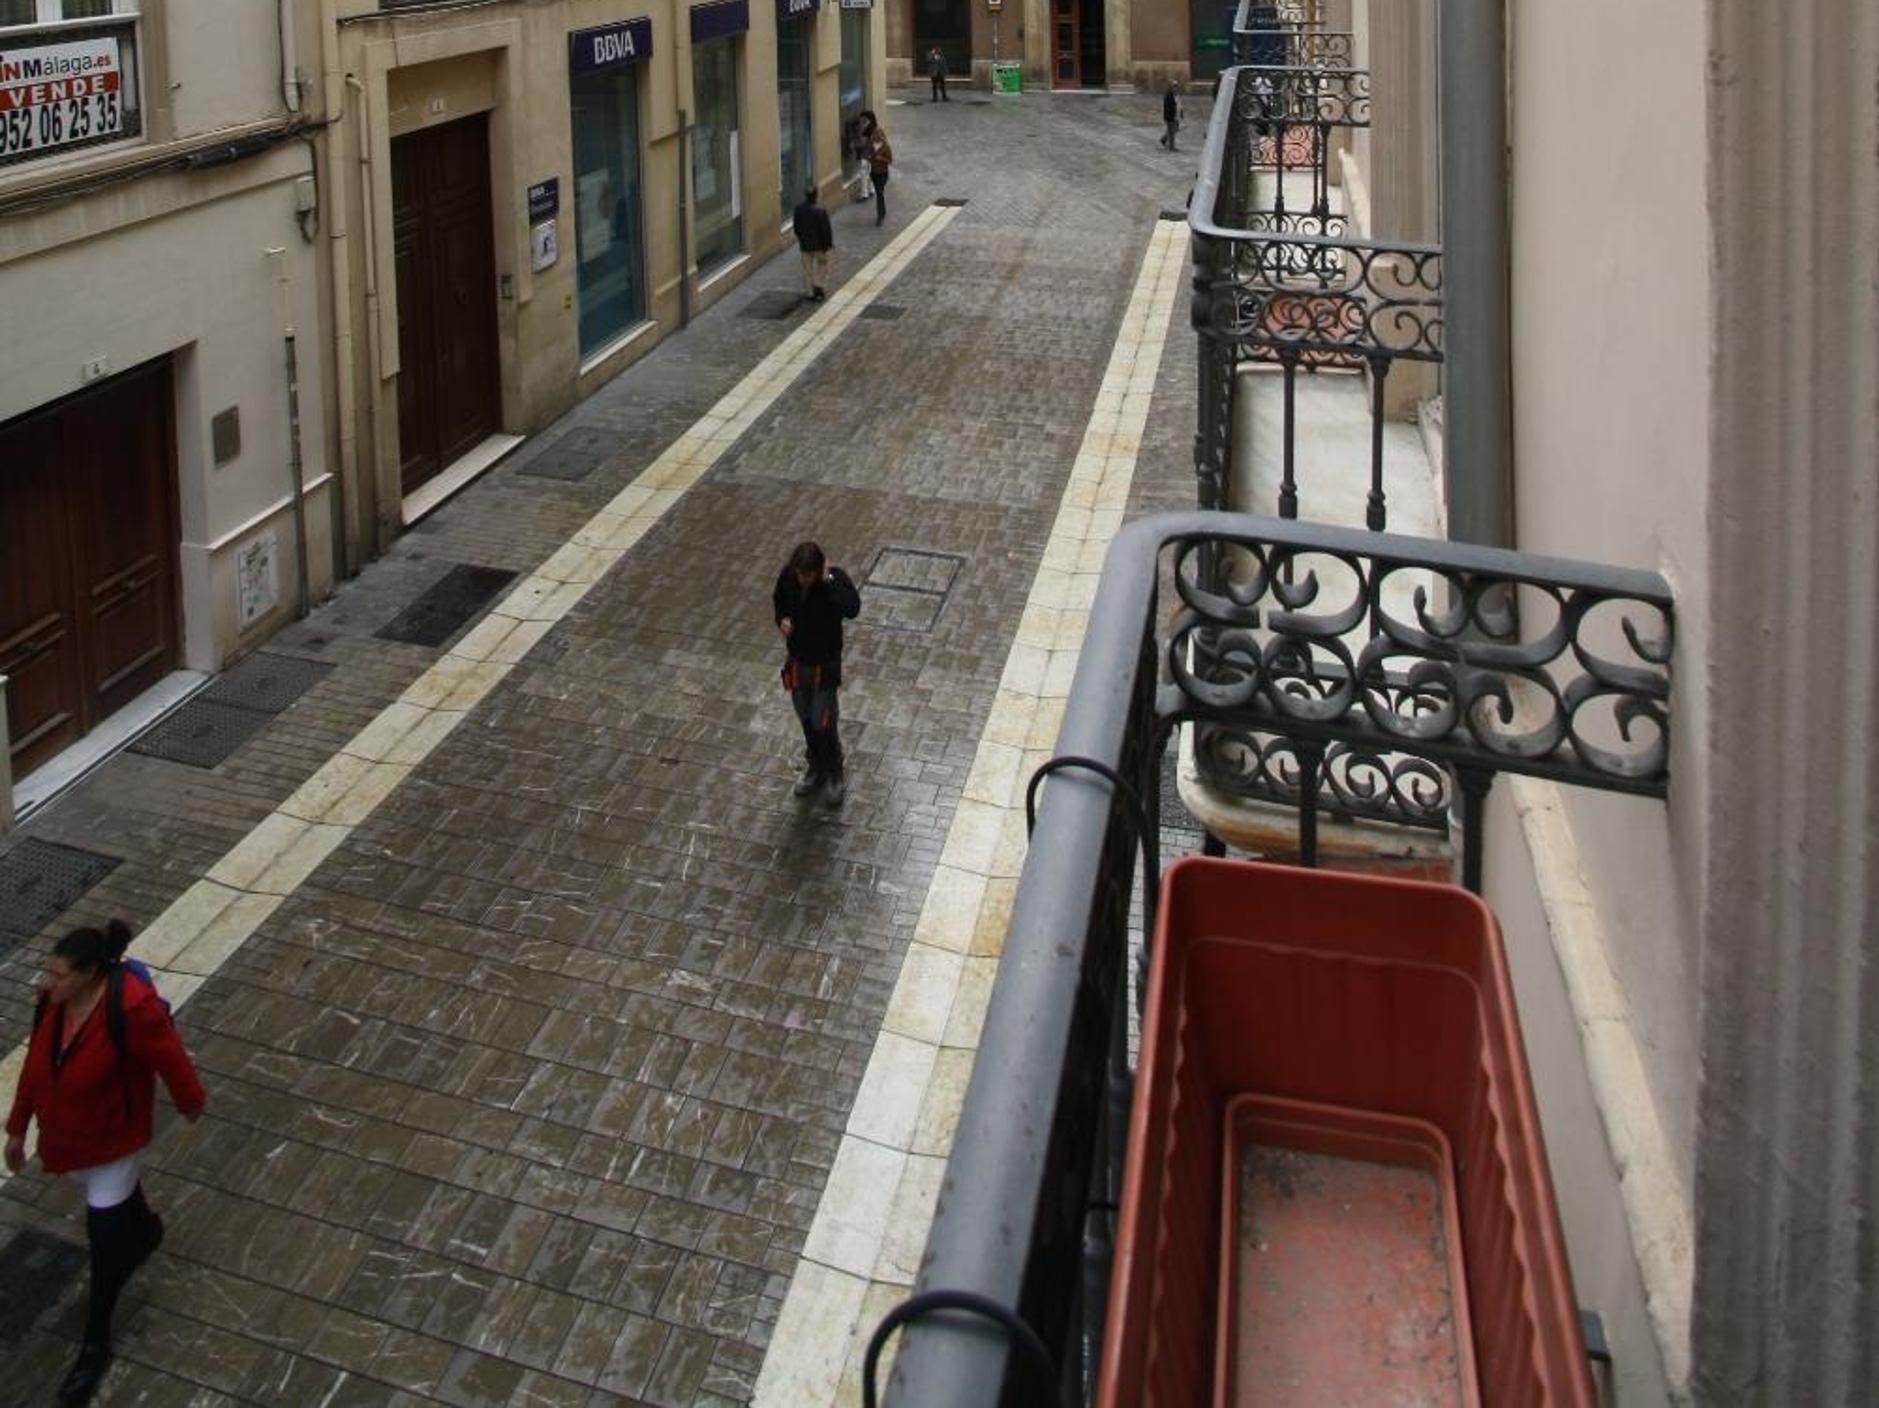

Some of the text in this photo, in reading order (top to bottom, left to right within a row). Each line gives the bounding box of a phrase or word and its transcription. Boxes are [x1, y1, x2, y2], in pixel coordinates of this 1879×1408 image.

[594, 30, 635, 64] BBVA
[9, 74, 105, 108] VENDE
[0, 93, 117, 153] 952 06 25 35
